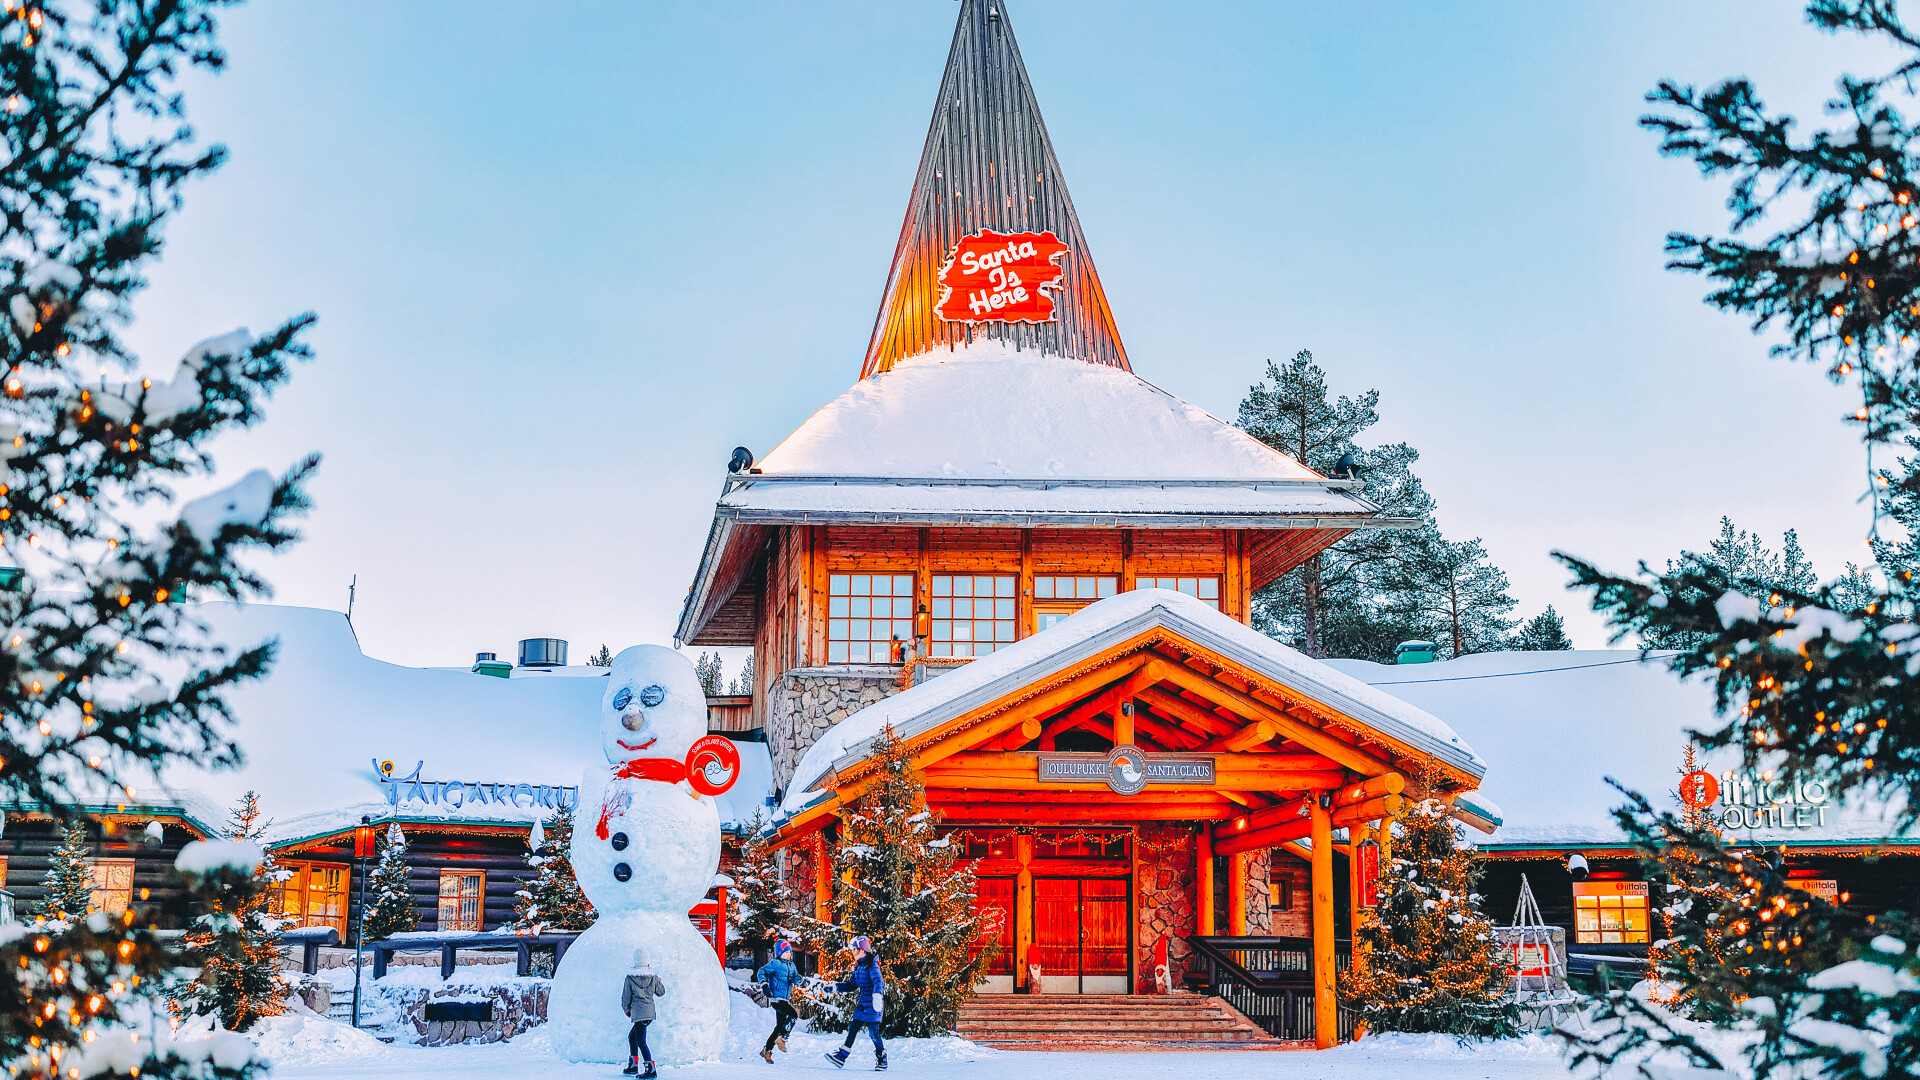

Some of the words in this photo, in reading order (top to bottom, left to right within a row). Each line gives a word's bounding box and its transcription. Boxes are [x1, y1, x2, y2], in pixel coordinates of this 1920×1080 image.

[960, 241, 1037, 275] Santa
[988, 267, 1022, 292] Is
[968, 286, 1029, 316] Here
[1046, 762, 1106, 776] JOULUPUKKI
[1147, 765, 1178, 777] SANTA
[1179, 765, 1210, 777] CLAUS
[372, 758, 580, 810] TAIGAKORU
[1722, 805, 1831, 829] OUTLET
[1624, 882, 1647, 890] iittala
[1811, 881, 1836, 889] iittala
